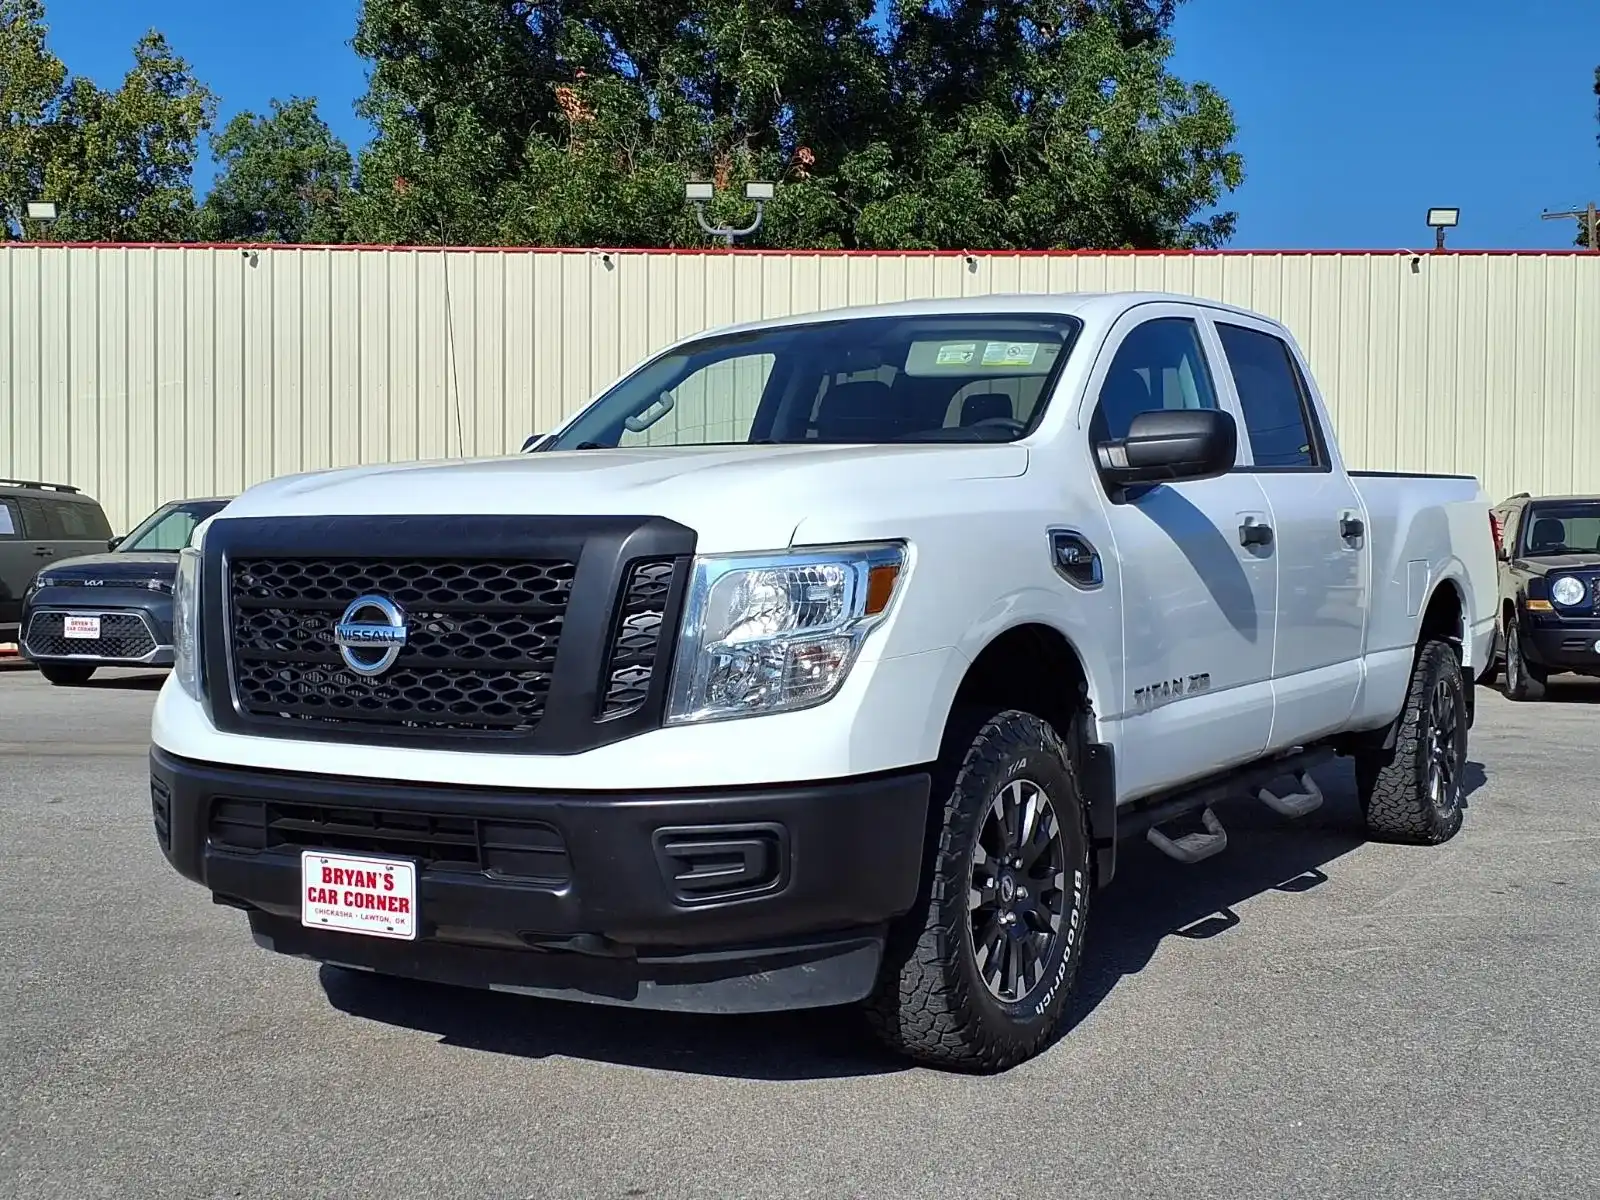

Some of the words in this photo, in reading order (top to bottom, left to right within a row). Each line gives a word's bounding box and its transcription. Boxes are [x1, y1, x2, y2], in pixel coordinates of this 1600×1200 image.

[339, 629, 396, 641] NISSAN
[1134, 678, 1184, 704] TITAN
[1008, 758, 1027, 777] T/A
[322, 867, 394, 891] BRYAN'S
[308, 887, 338, 905] CAR
[344, 891, 410, 913] CORNER
[315, 908, 353, 918] CHICKASHA
[360, 913, 392, 924] LAWTON,
[1035, 869, 1081, 1015] BFGoodrich
